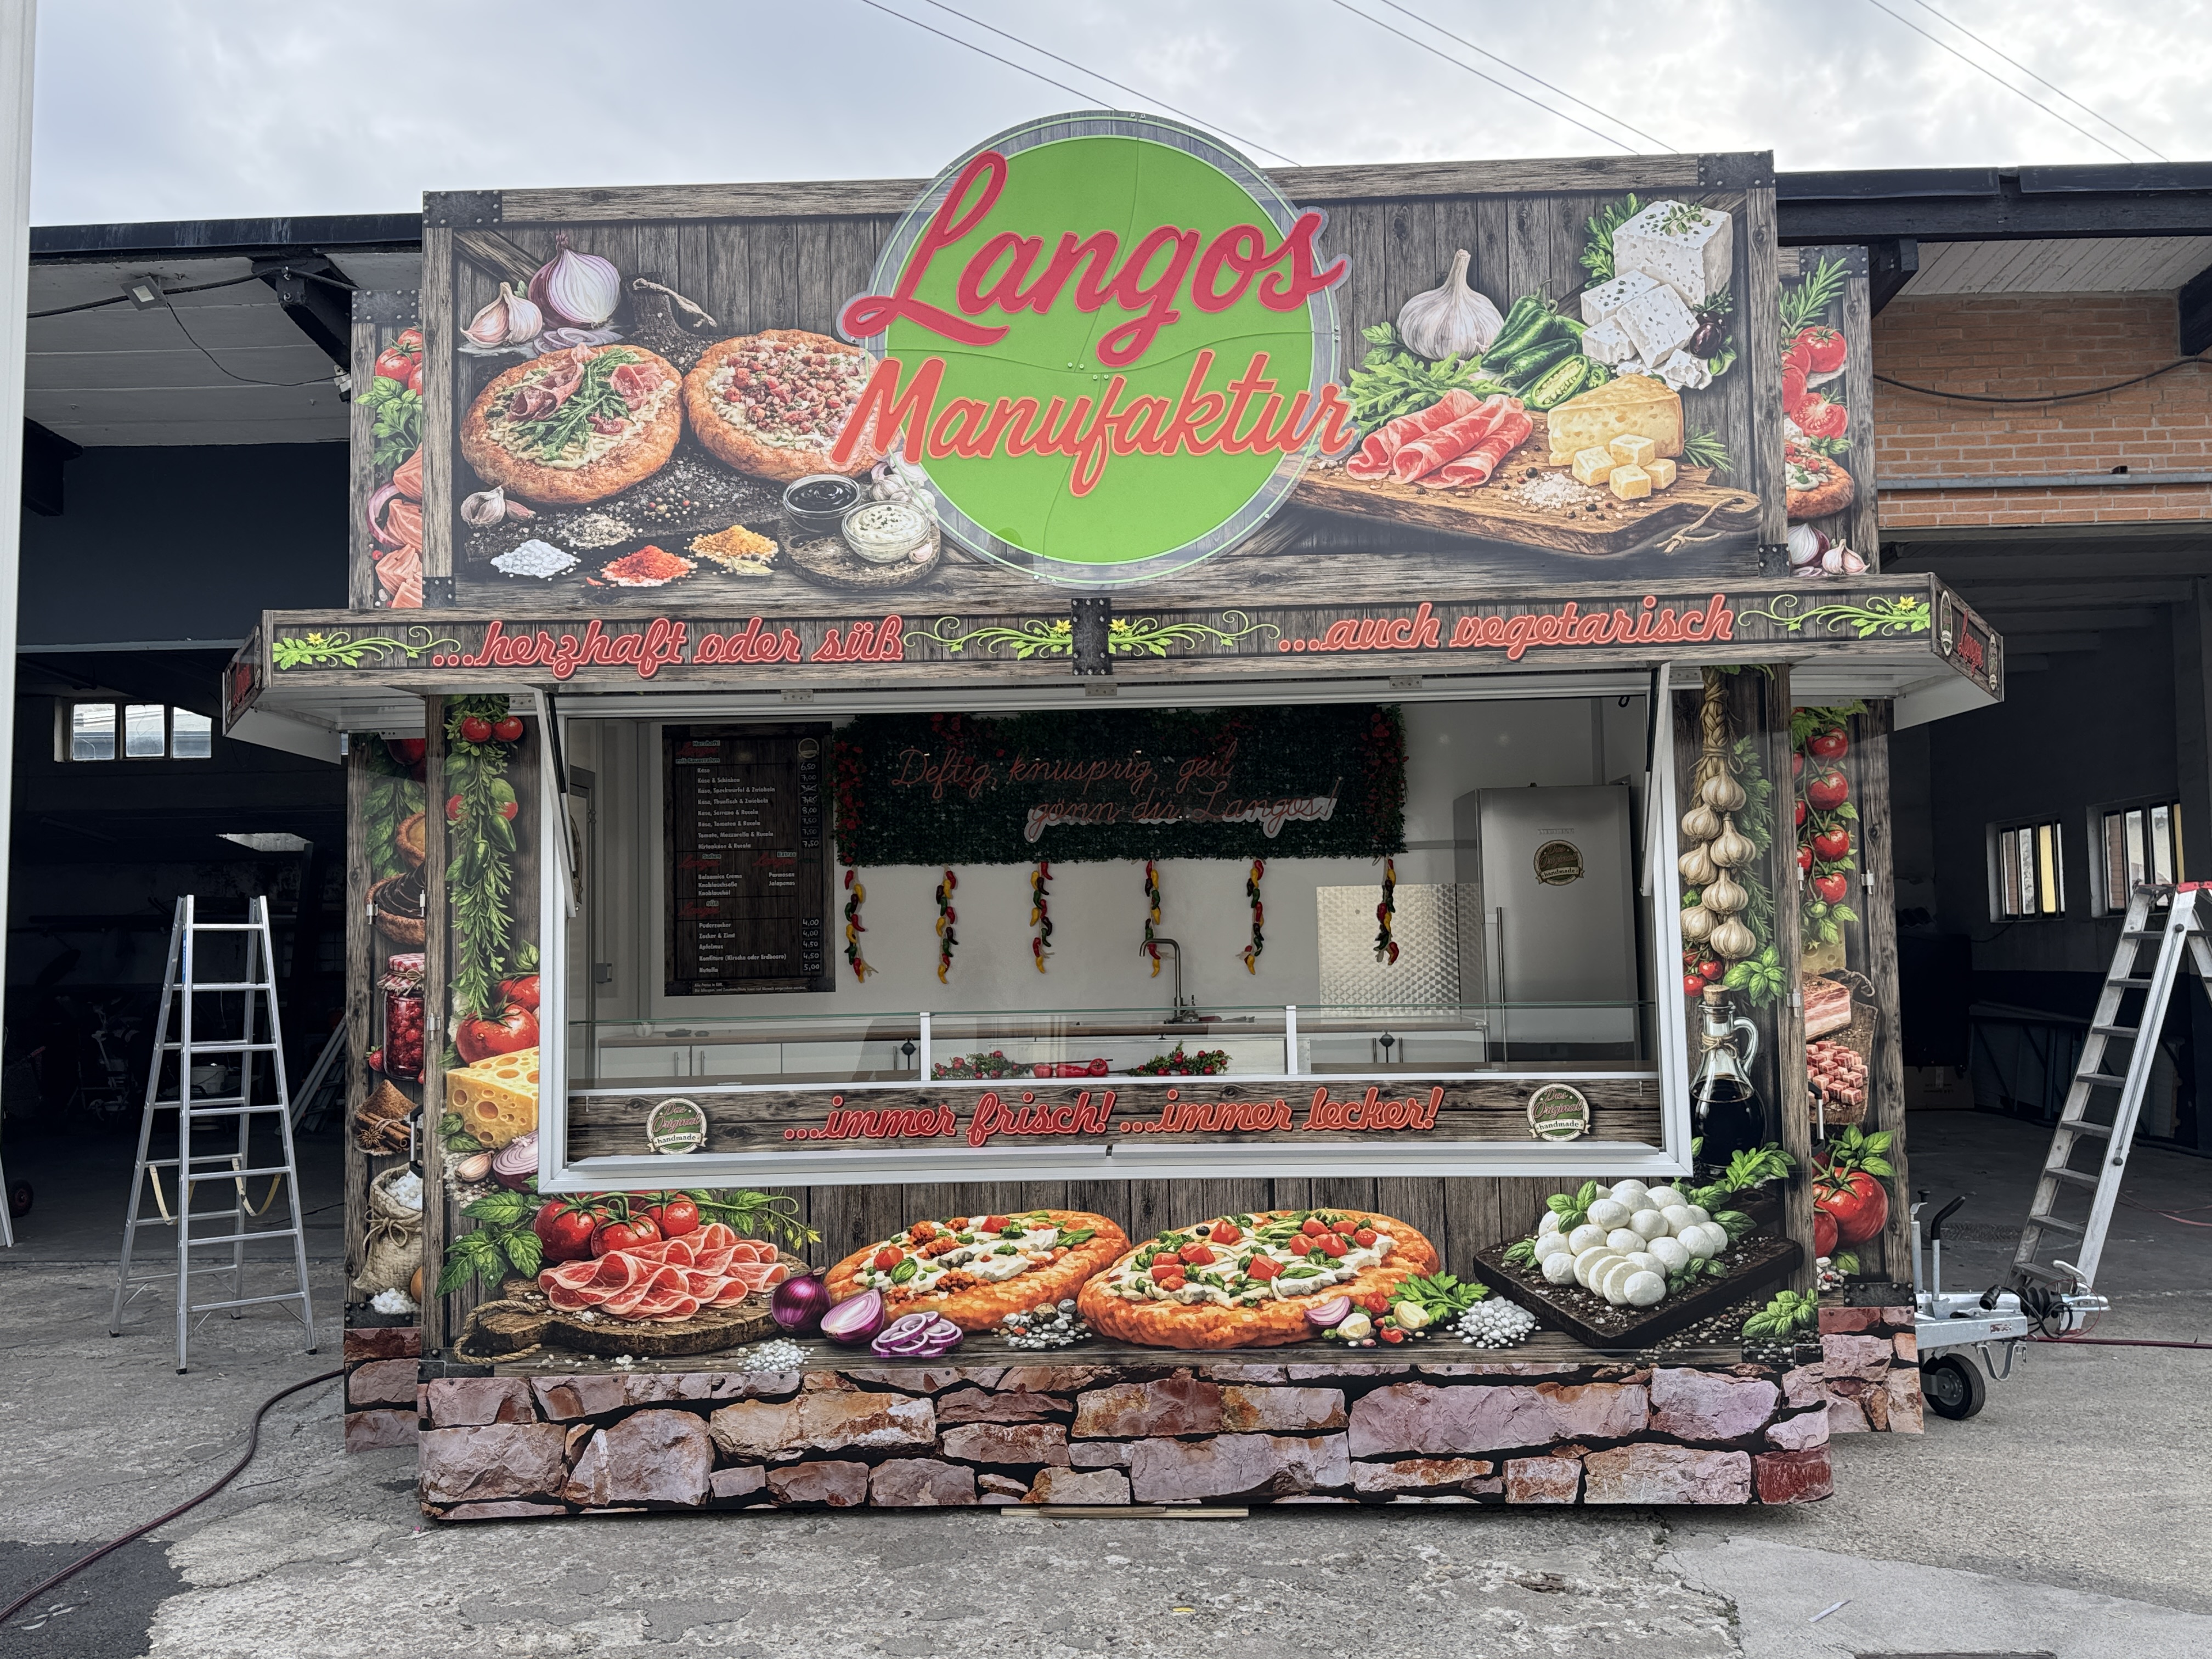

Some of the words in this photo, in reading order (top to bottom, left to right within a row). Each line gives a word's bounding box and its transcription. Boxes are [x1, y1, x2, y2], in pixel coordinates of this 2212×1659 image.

[843, 151, 1346, 366] Langos
[831, 349, 1355, 498] Manufaktur
[1278, 601, 1440, 652] ...auch
[1449, 594, 1734, 661] vegetarisch
[432, 617, 687, 680] ...herzhaft
[693, 616, 801, 664] oder
[810, 614, 903, 662] süß
[800, 762, 816, 771] 6,50
[802, 806, 817, 815] 8,00
[1029, 798, 1120, 838] gönn
[1131, 788, 1181, 820] dir
[802, 840, 819, 849] 7,50
[1544, 868, 1575, 877] handmade
[802, 918, 819, 927] 4,00
[1544, 1088, 1568, 1102] Das
[664, 1102, 687, 1116] Das
[1533, 1099, 1583, 1119] Original
[652, 1113, 702, 1133] Original
[783, 1094, 957, 1141] ...immer
[967, 1092, 1117, 1147] frisch!
[1119, 1088, 1293, 1134] ...immer
[1302, 1086, 1445, 1131] lecker!
[1539, 1121, 1579, 1130] handmade
[657, 1134, 696, 1144] handmade
